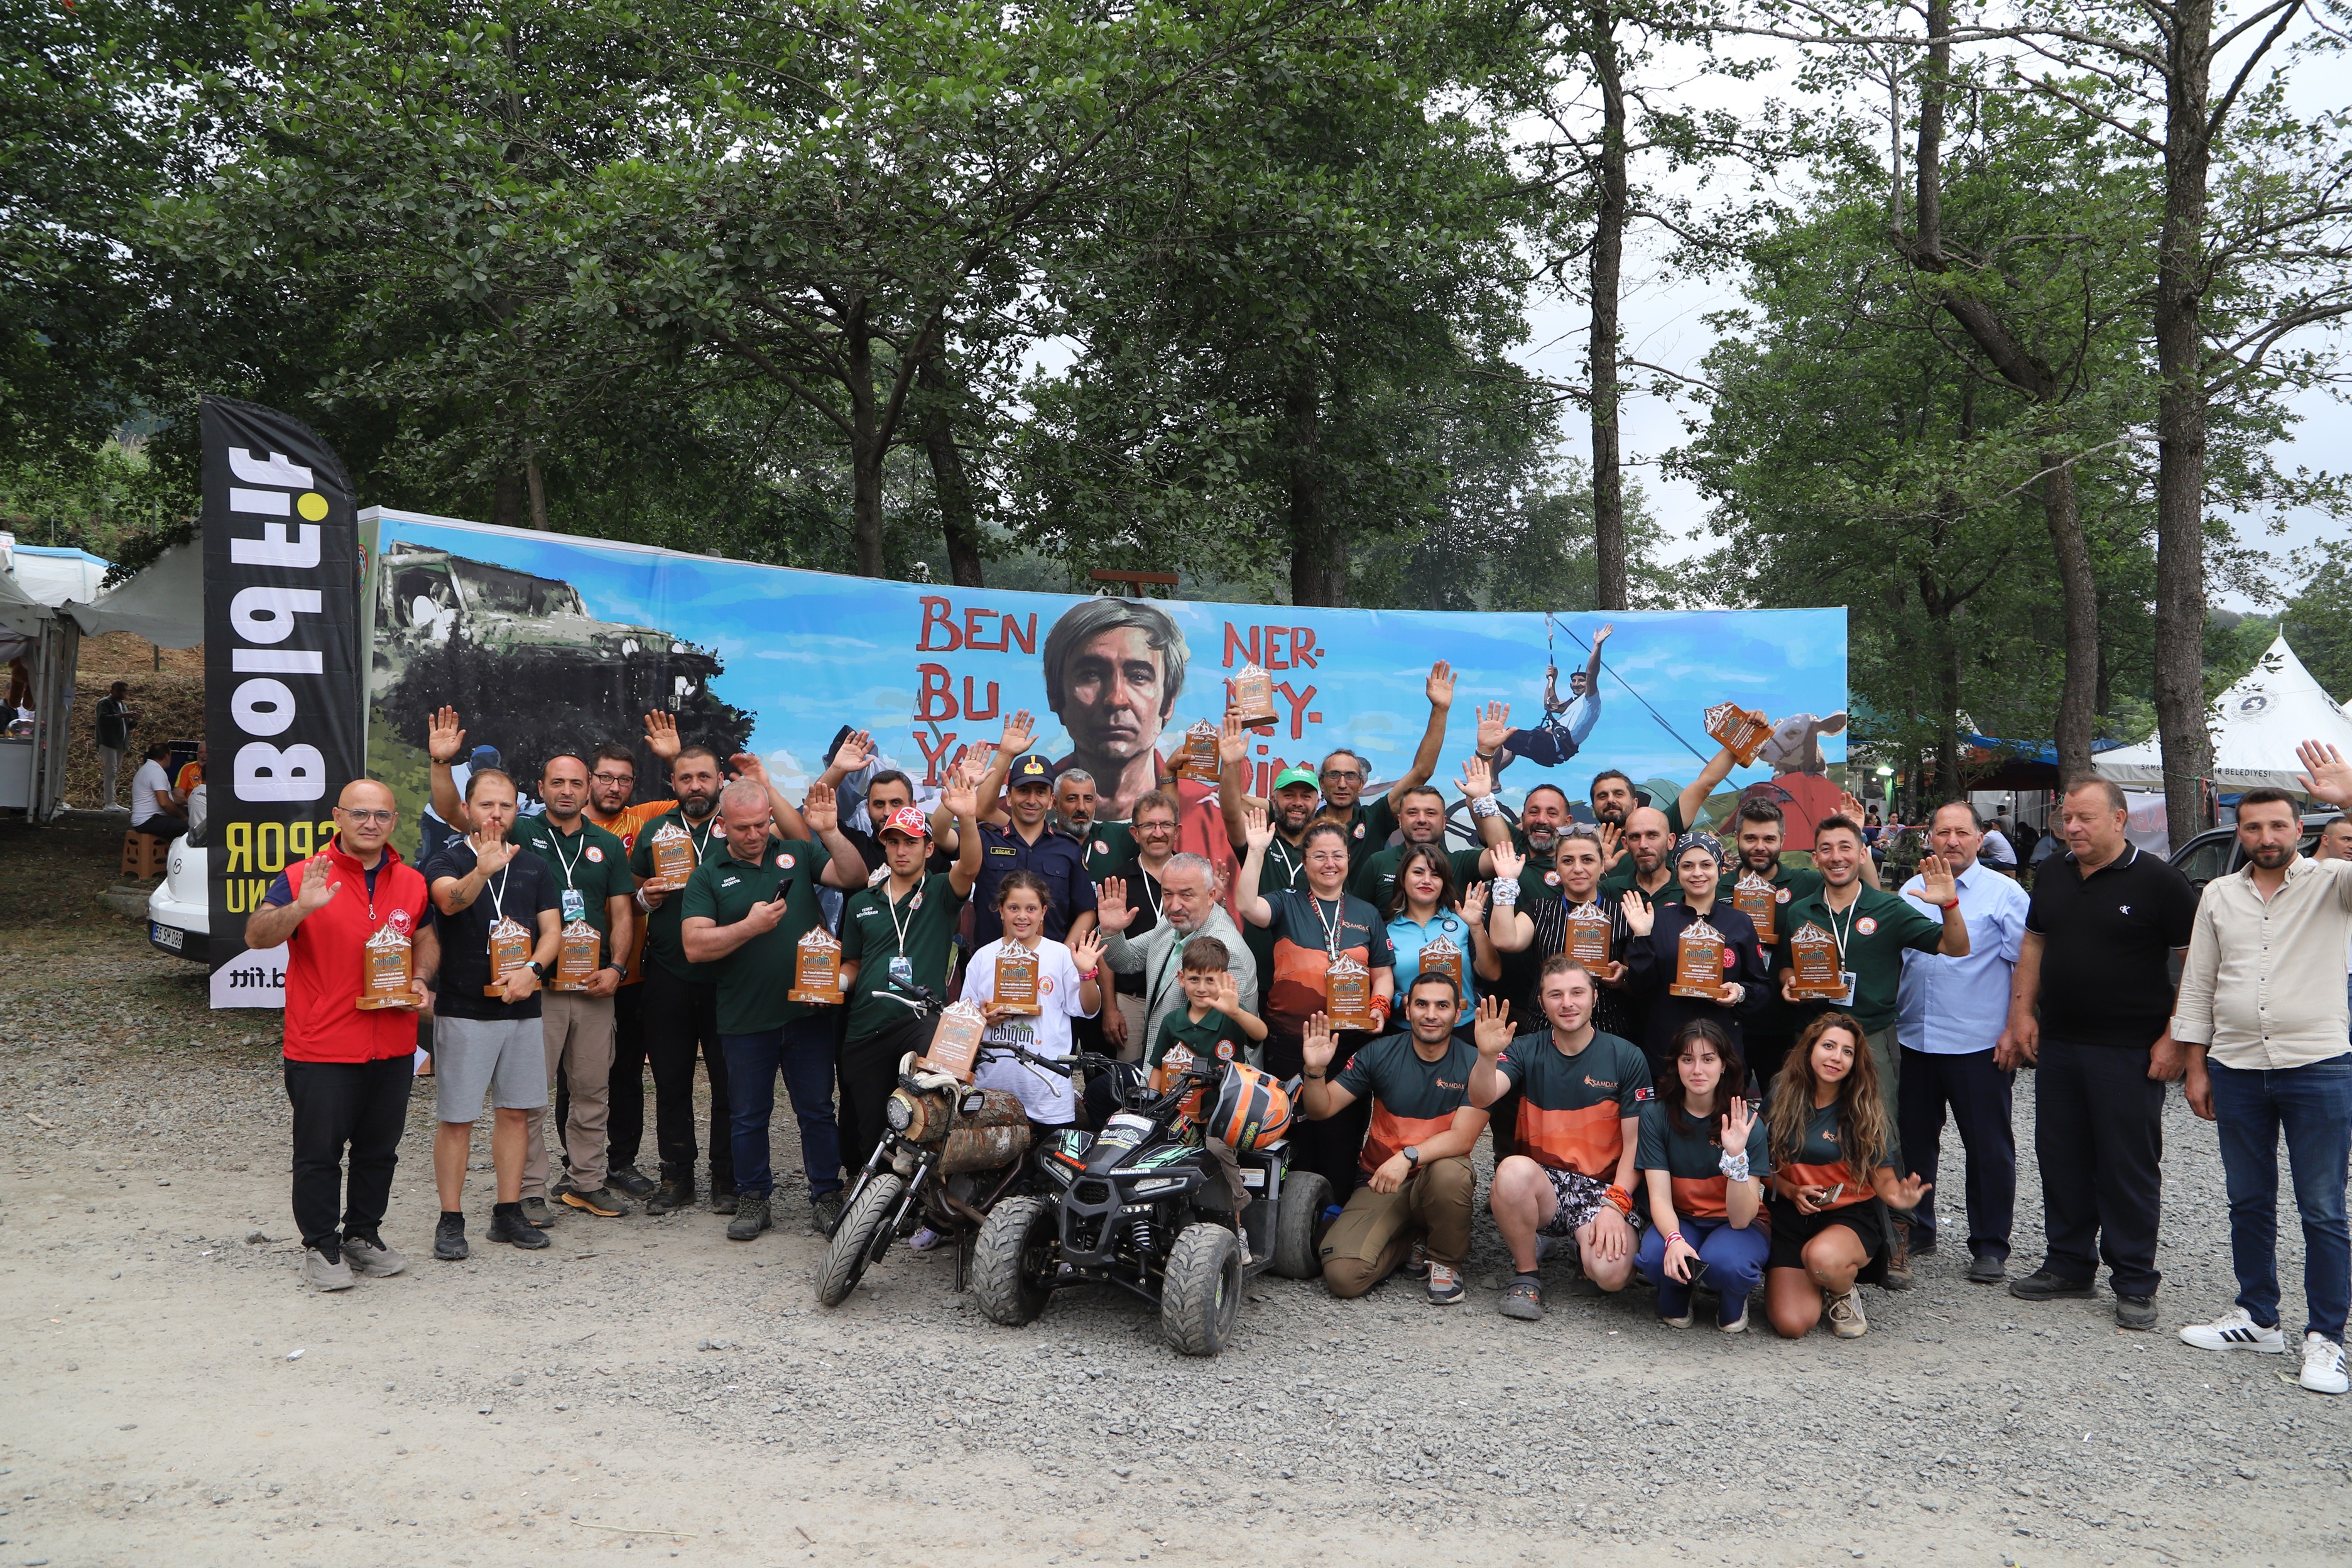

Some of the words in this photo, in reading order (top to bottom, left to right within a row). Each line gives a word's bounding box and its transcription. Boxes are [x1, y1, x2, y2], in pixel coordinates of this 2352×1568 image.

[916, 596, 1037, 654] BEN
[914, 663, 1000, 722] BU
[155, 926, 161, 939] 55
[163, 929, 171, 943] SM
[172, 931, 182, 947] 088
[991, 1023, 1034, 1045] ebiyan
